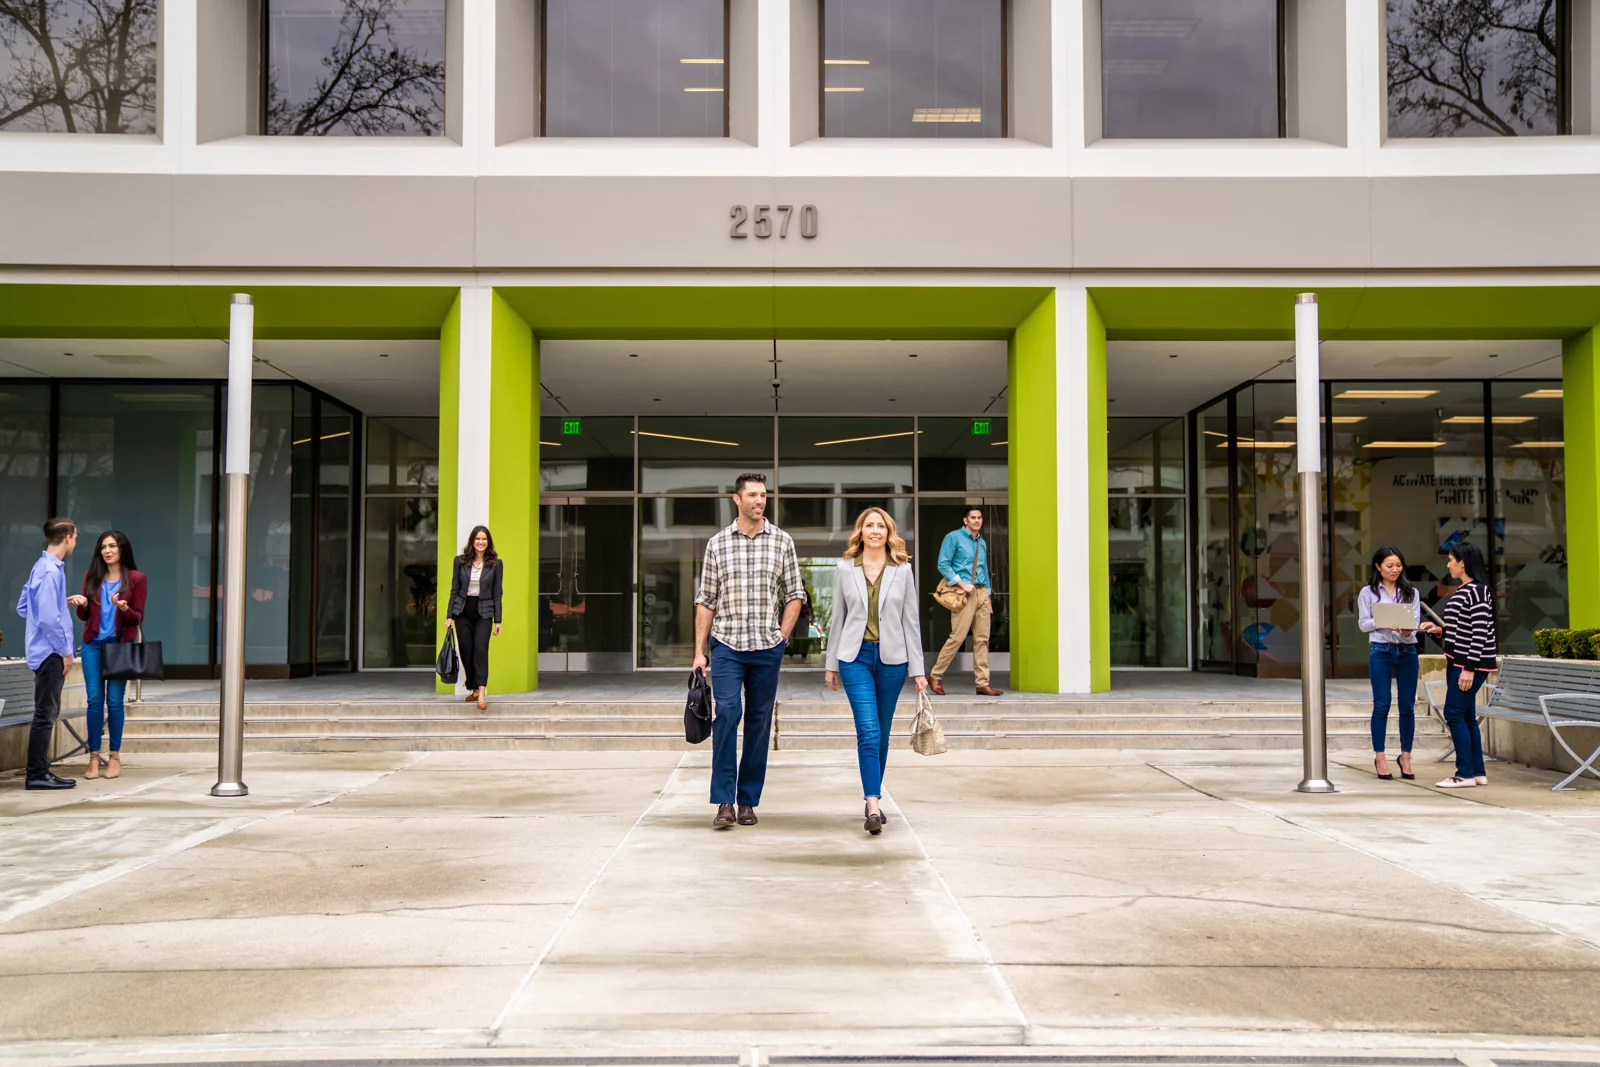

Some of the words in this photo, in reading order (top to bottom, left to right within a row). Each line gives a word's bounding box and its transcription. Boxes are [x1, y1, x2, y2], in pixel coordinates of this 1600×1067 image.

[729, 204, 818, 239] 2570
[564, 421, 580, 434] EXIT
[974, 421, 990, 434] EXIT
[1440, 474, 1456, 487] THE
[1458, 474, 1483, 487] BODY
[1478, 489, 1501, 504] TE
